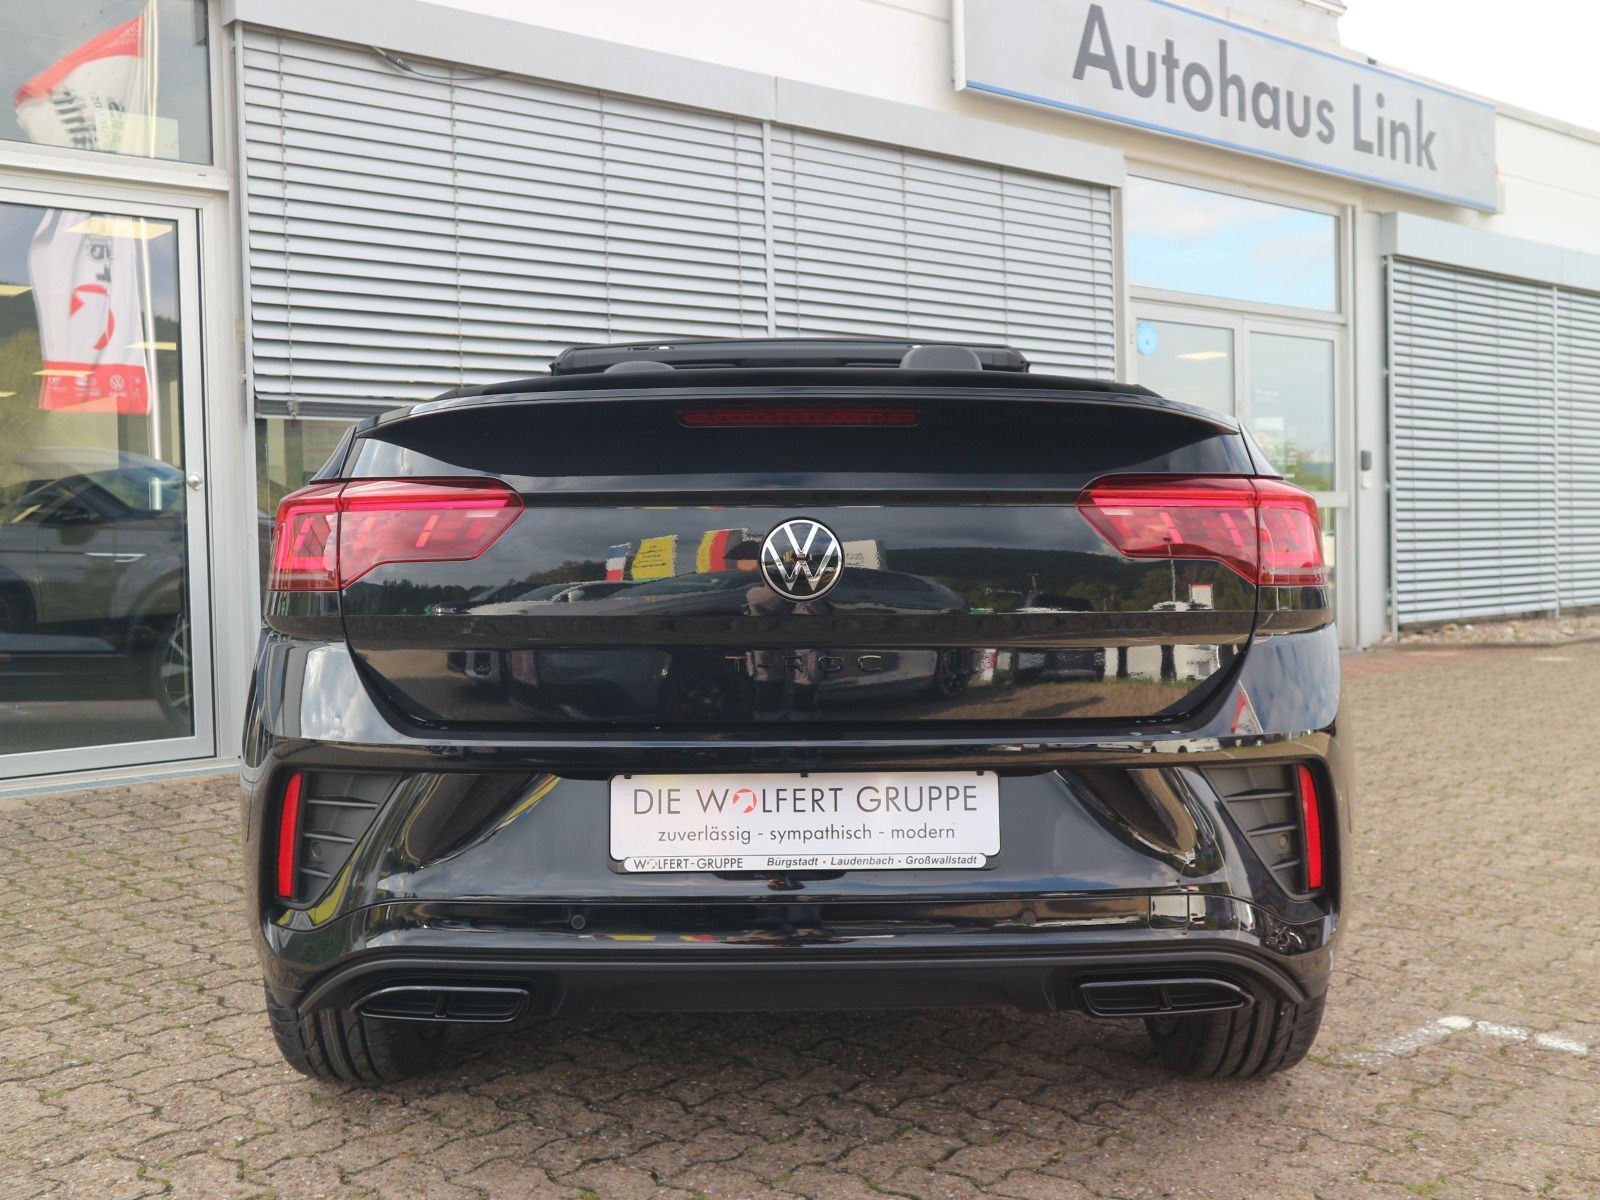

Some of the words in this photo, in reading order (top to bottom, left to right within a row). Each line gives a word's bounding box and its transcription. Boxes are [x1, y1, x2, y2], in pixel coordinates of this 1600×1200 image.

[1072, 3, 1336, 145] Autohaus
[1352, 83, 1438, 171] Link
[633, 788, 681, 815] DIE
[856, 785, 978, 813] GRUPPE
[657, 823, 752, 845] zuverlässig
[769, 823, 873, 846] sympathisch
[891, 823, 955, 840] modern
[766, 855, 819, 867] Bürgstadt
[830, 855, 895, 866] Laudenbach
[905, 854, 978, 866] Großwallstadt
